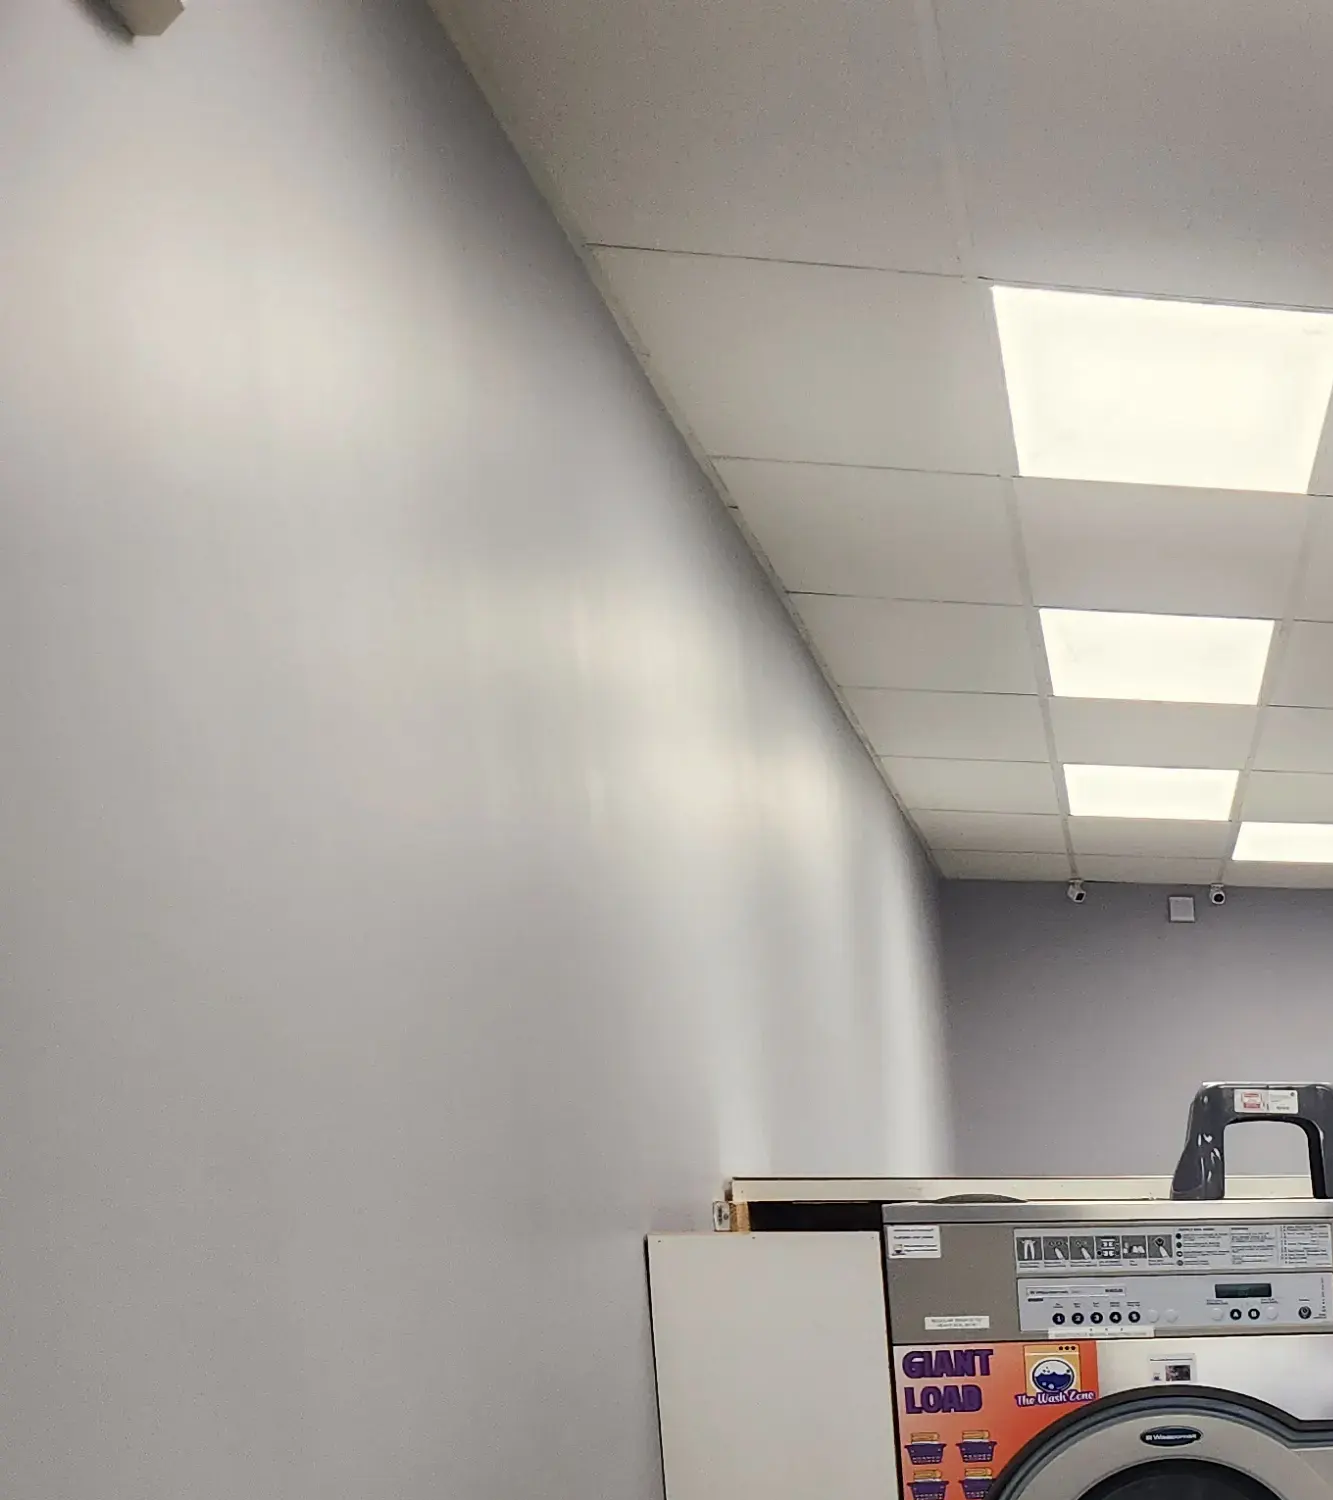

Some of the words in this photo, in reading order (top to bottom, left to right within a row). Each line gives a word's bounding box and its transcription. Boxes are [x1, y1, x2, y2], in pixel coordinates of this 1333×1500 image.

[902, 1348, 994, 1379] GIANT
[904, 1384, 983, 1414] LOAD
[1016, 1395, 1035, 1406] The
[1037, 1391, 1068, 1404] Wash
